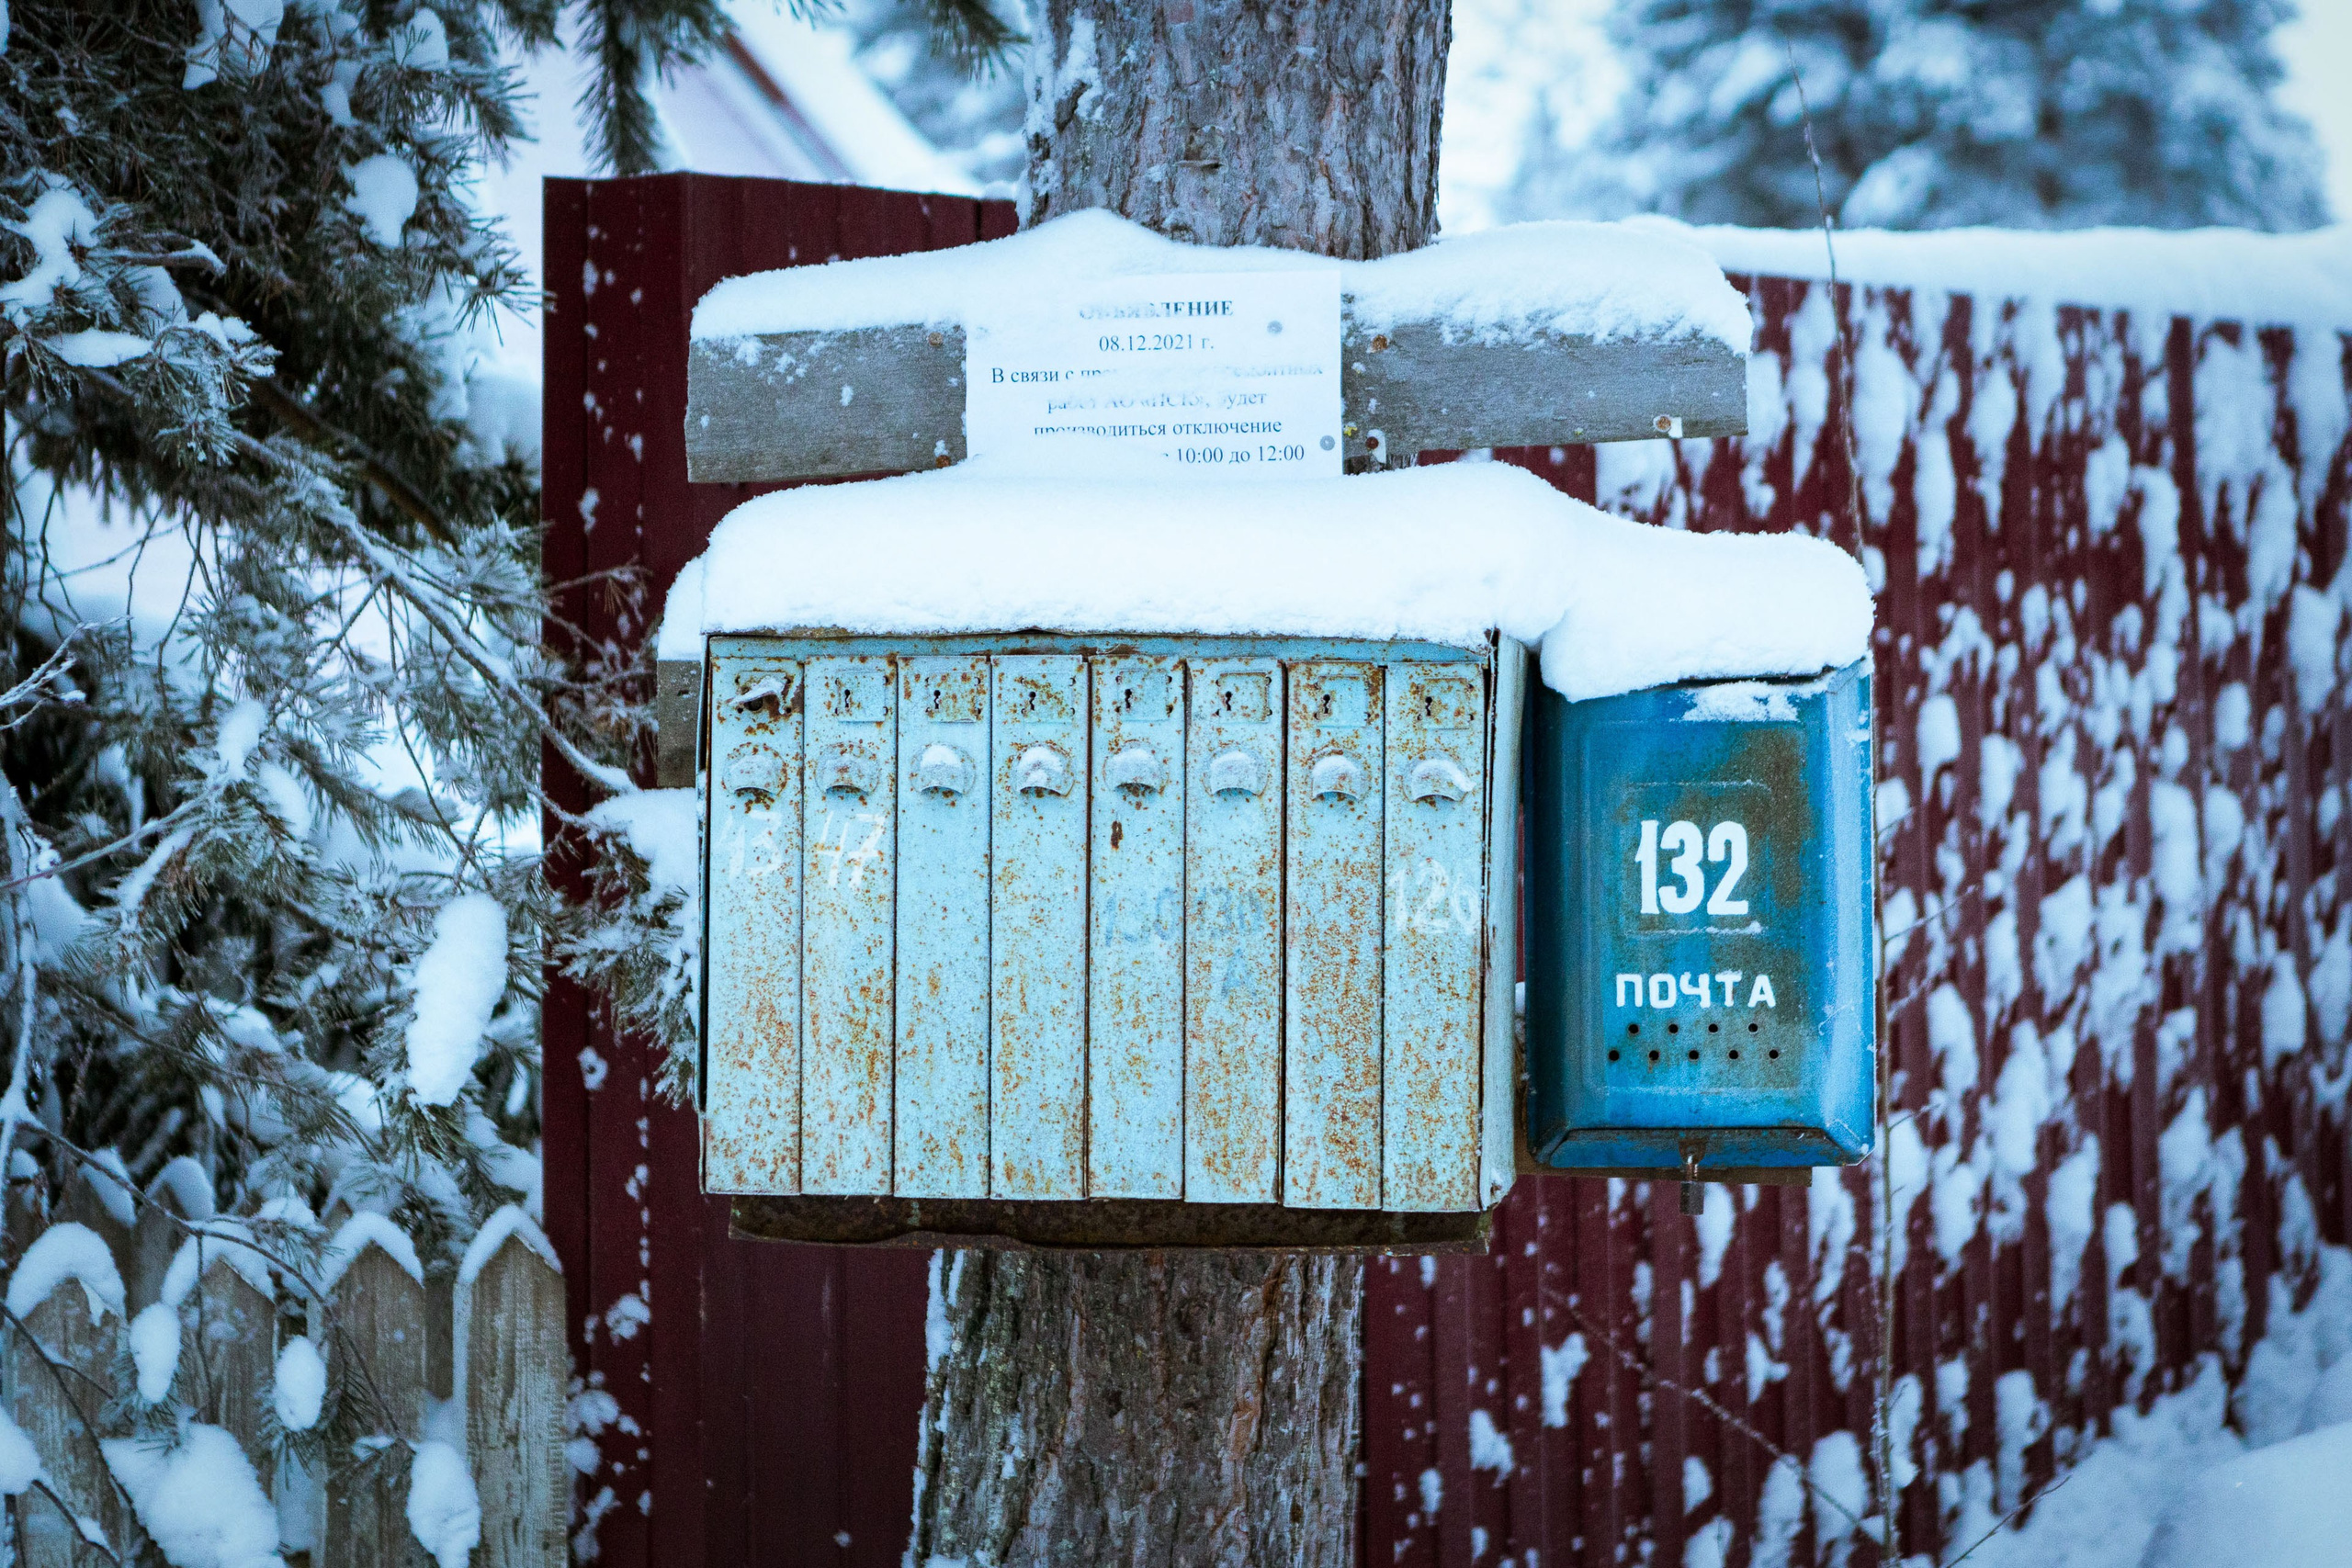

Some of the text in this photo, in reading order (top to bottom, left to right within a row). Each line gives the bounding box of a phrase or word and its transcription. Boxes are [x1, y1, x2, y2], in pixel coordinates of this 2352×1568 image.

[1099, 333, 1215, 352] 08.12.2021 г.
[991, 367, 1004, 383] В
[1011, 370, 1058, 383] связи
[1065, 369, 1074, 380] с
[1172, 420, 1283, 435] отключение
[1177, 445, 1305, 465] 10:00 до 12:00
[1634, 819, 1749, 916] 132
[1615, 970, 1777, 1010] ПОЧТА
